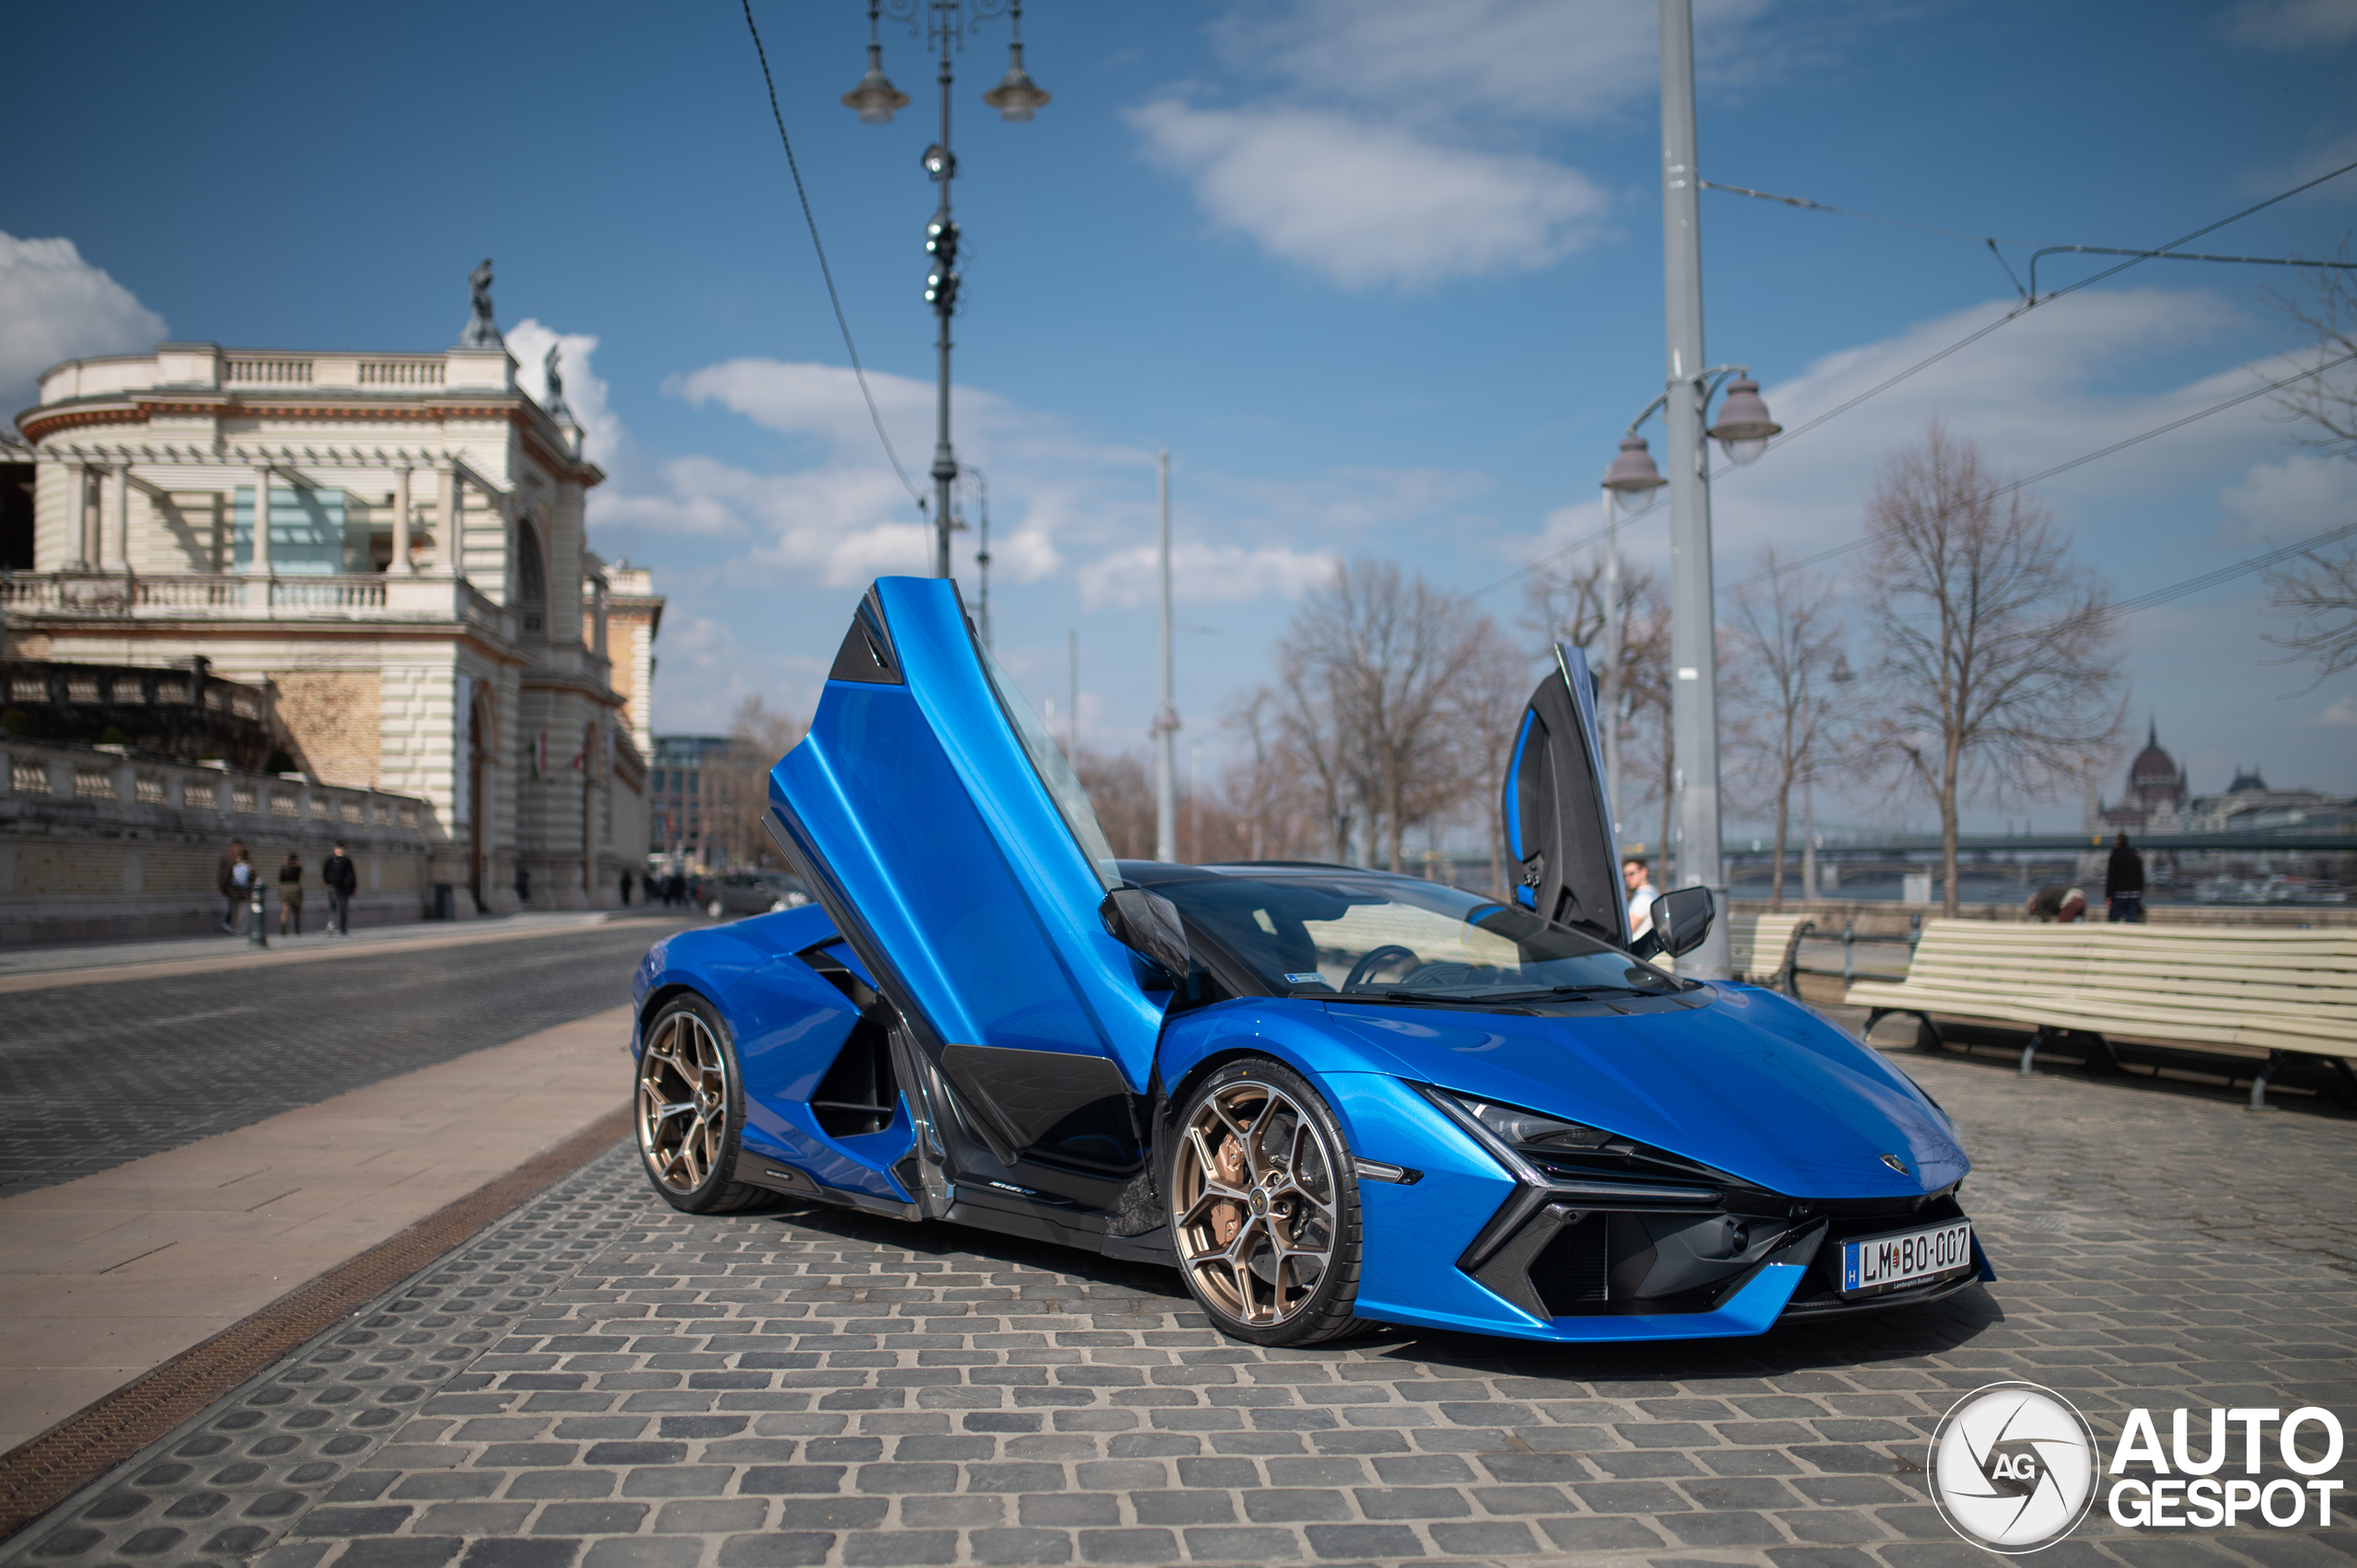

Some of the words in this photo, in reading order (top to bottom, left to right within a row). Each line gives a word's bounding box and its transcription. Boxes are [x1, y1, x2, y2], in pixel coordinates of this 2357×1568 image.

[1864, 1240, 1891, 1282] LM
[1849, 1270, 1856, 1283] H
[1893, 1279, 1917, 1289] Lamborghini
[1917, 1275, 1935, 1285] Budapest
